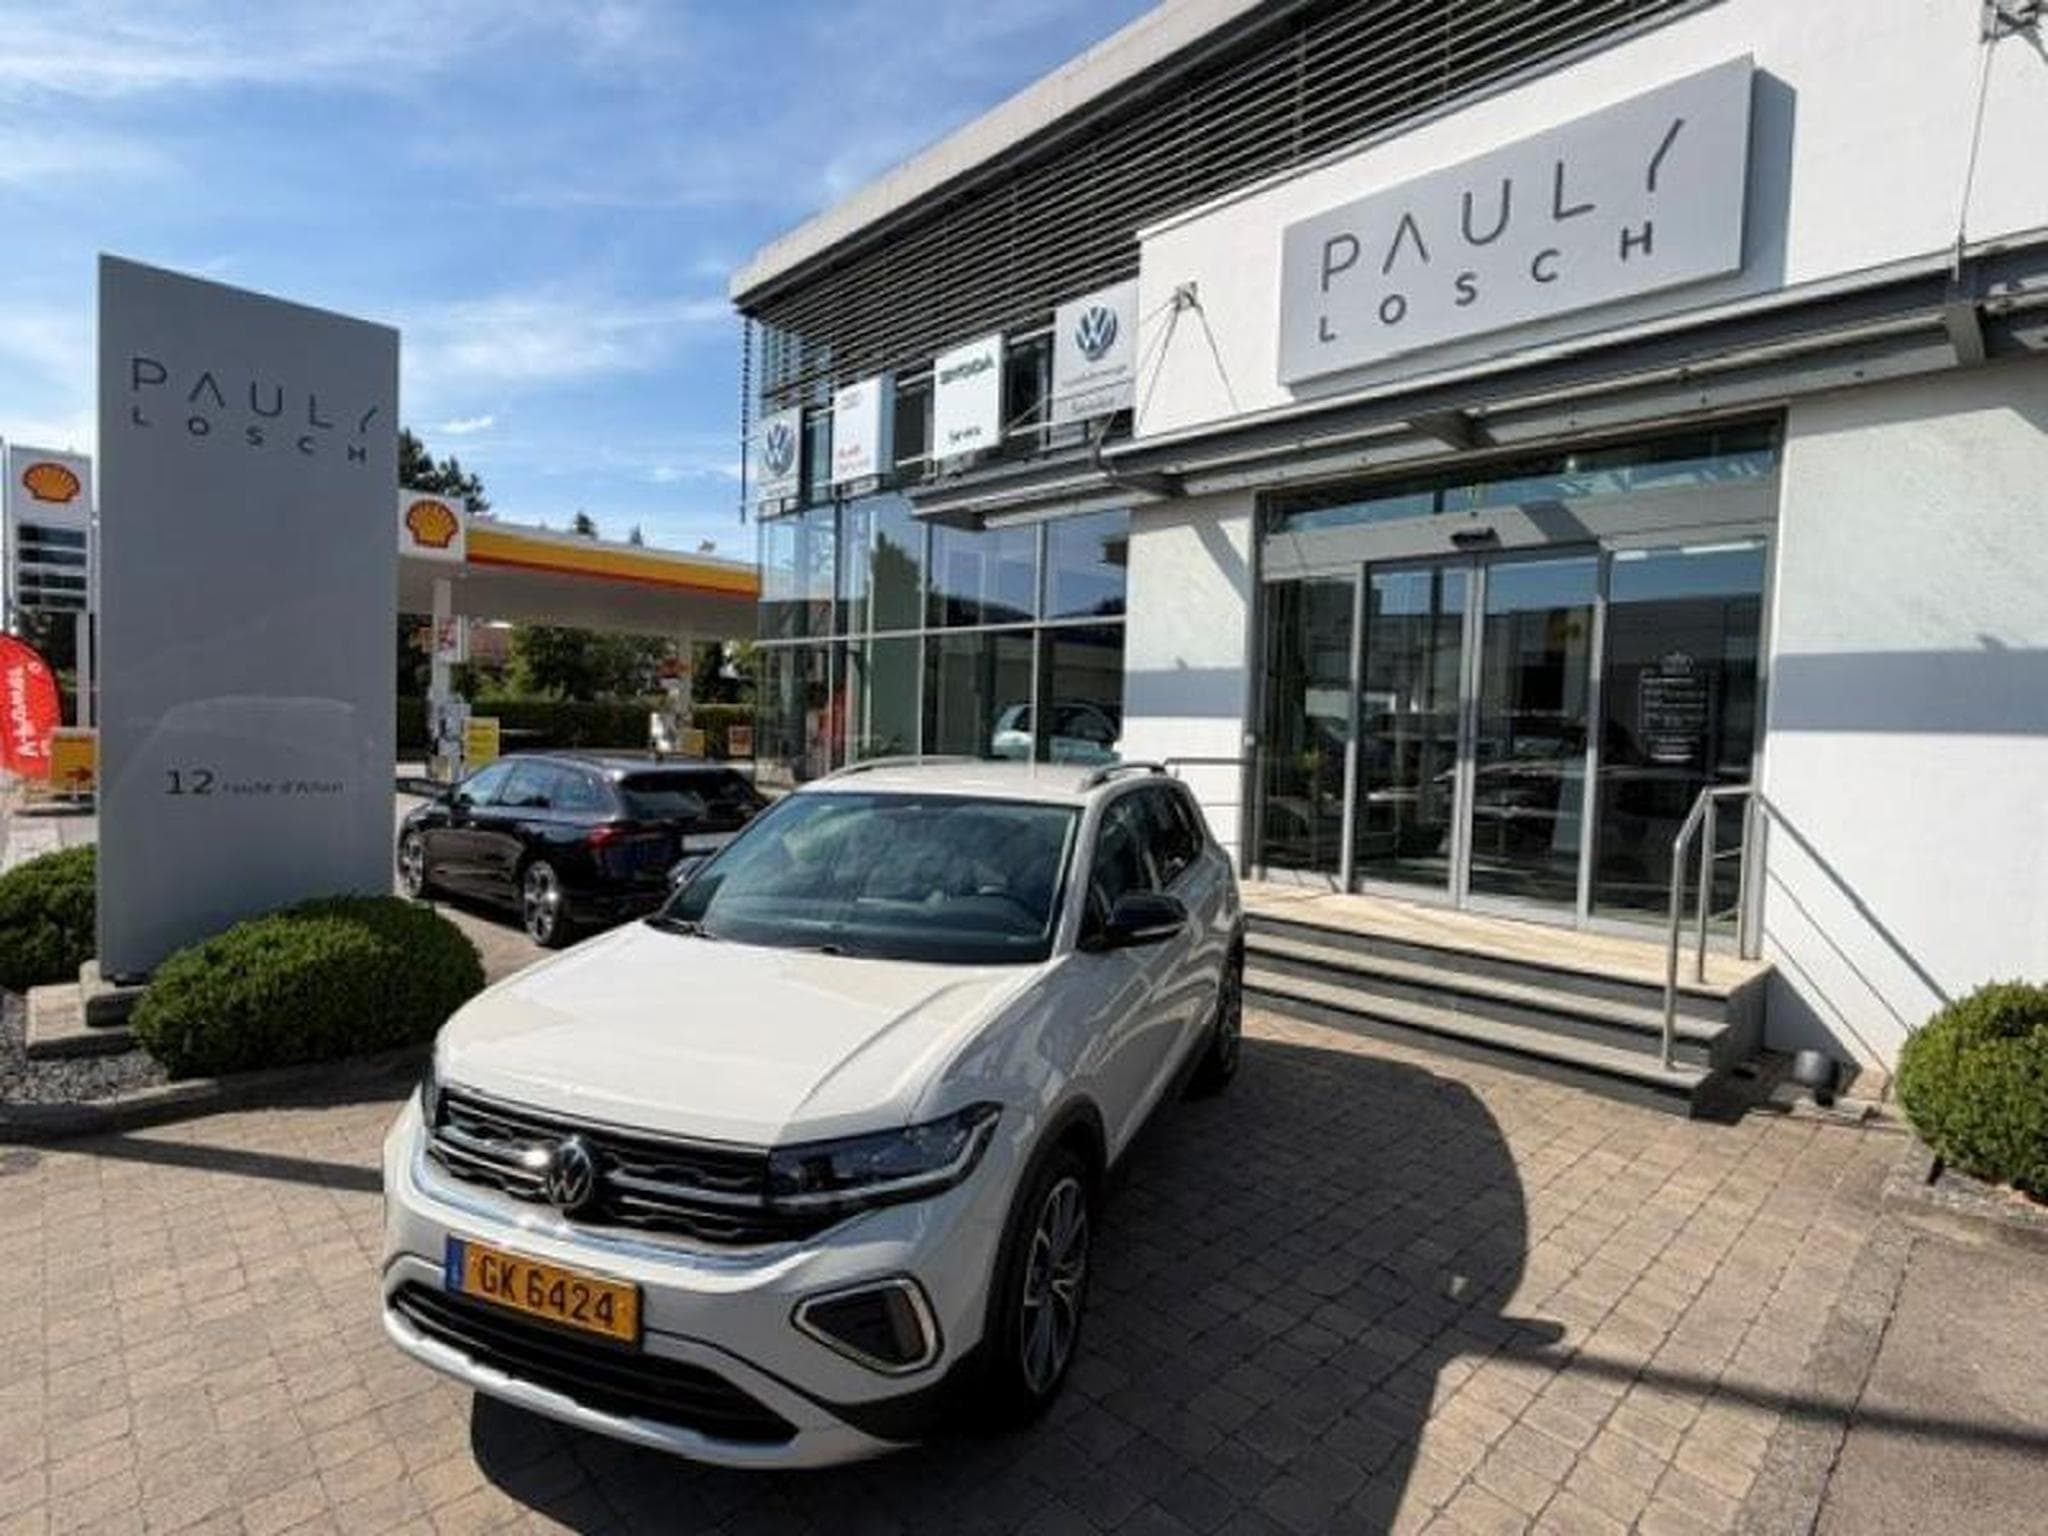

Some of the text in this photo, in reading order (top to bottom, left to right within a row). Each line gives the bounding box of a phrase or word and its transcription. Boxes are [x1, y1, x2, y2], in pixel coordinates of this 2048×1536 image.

[1318, 220, 1654, 343] LOSCH
[132, 405, 367, 463] LOSCH
[164, 768, 215, 795] 12
[480, 1253, 615, 1328] GK 6424
